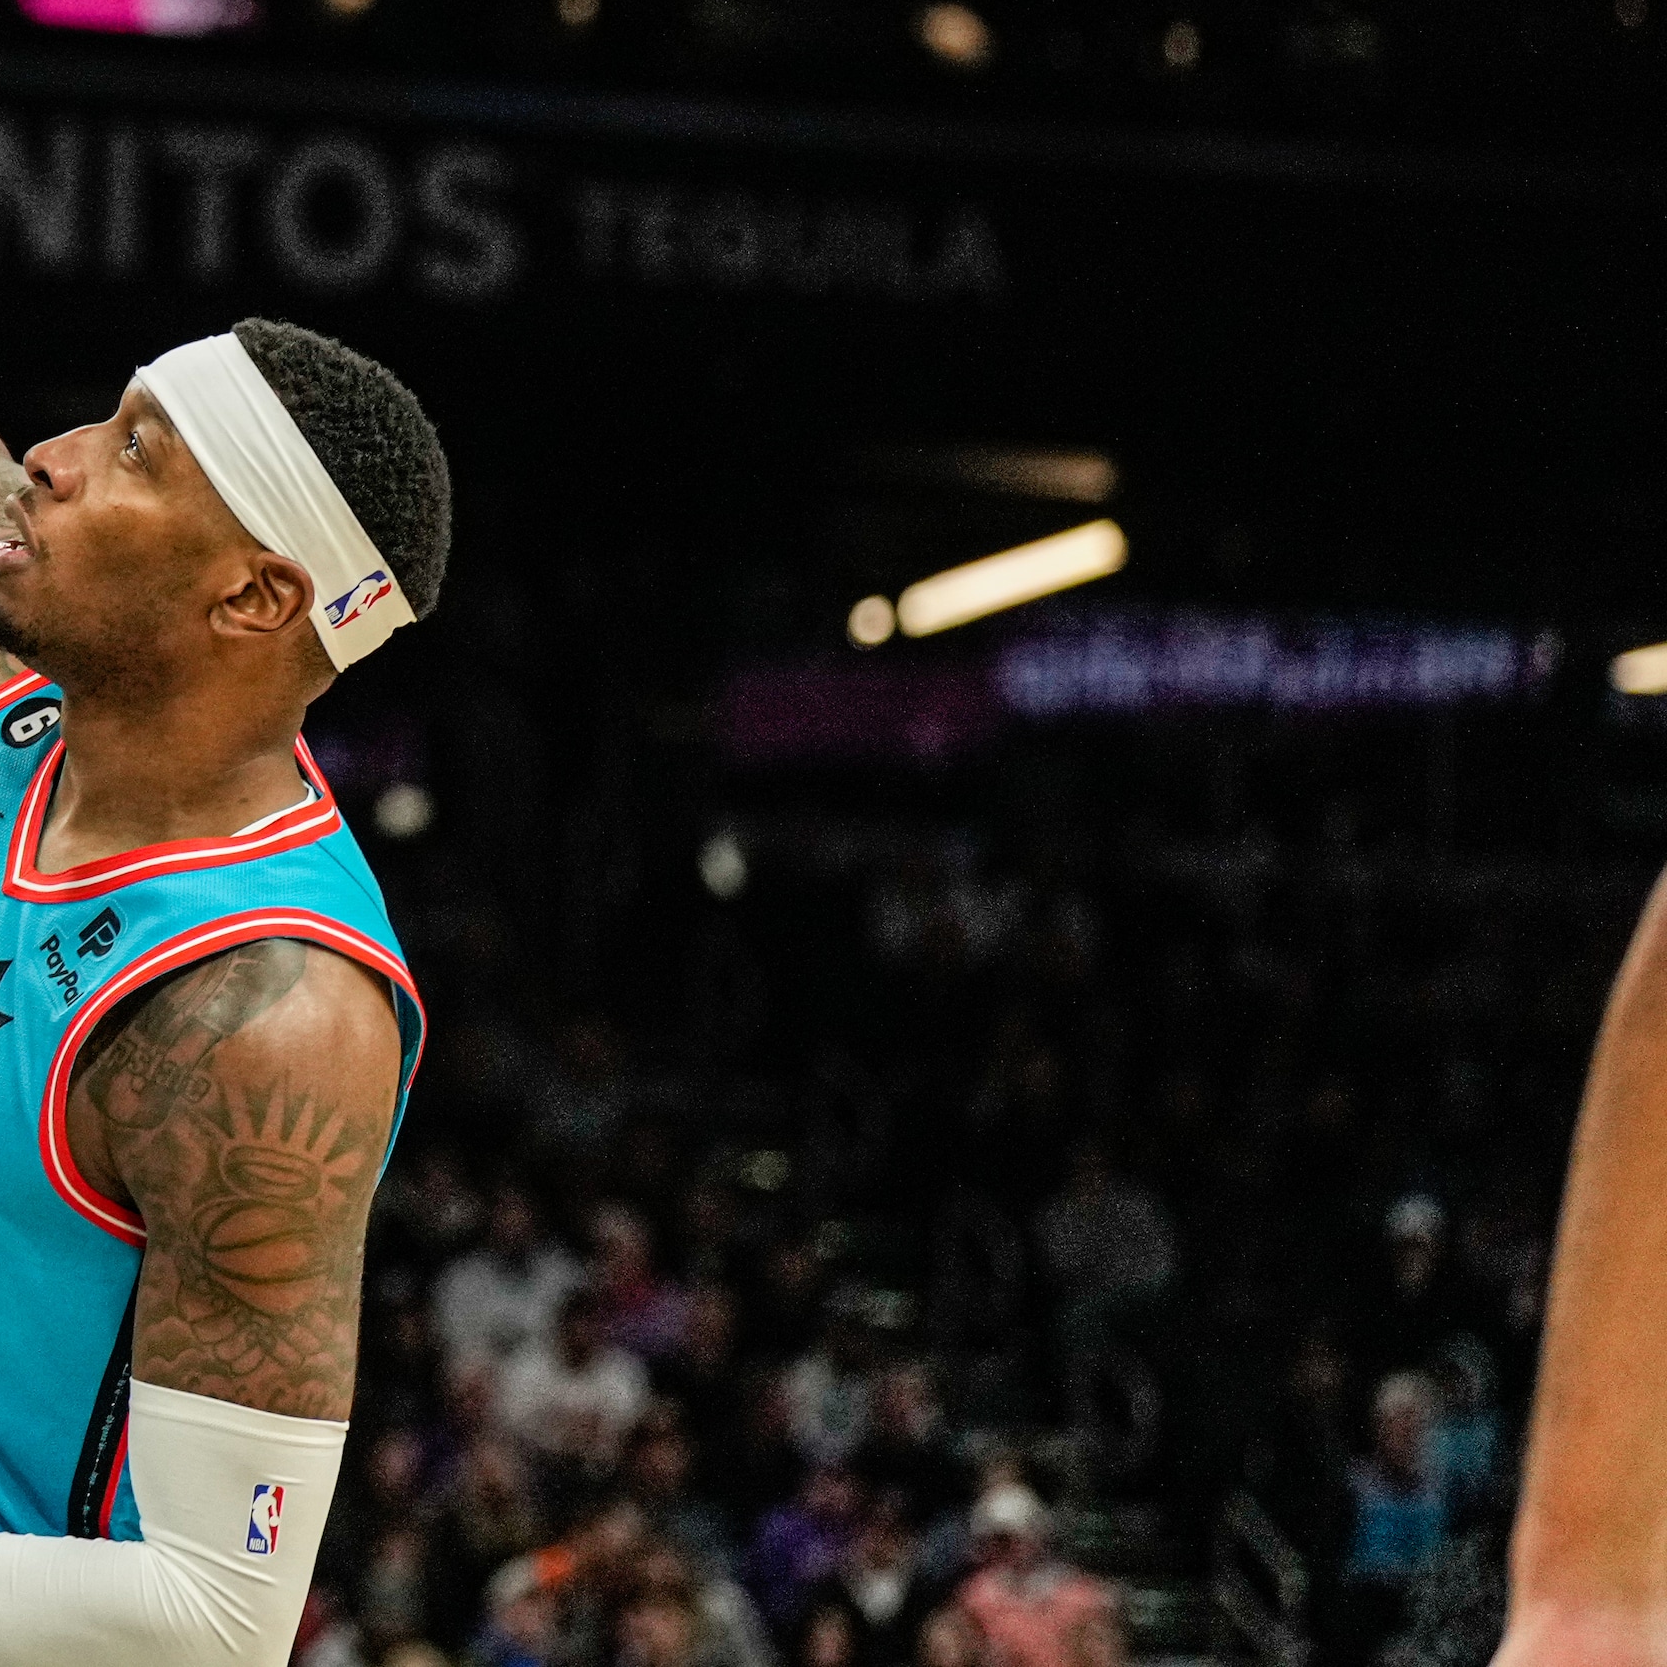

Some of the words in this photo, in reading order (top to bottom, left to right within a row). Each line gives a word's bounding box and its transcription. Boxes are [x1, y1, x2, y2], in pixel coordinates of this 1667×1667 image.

[9, 706, 61, 743] 6
[39, 933, 85, 1007] PayPal
[248, 1537, 266, 1552] NBA
